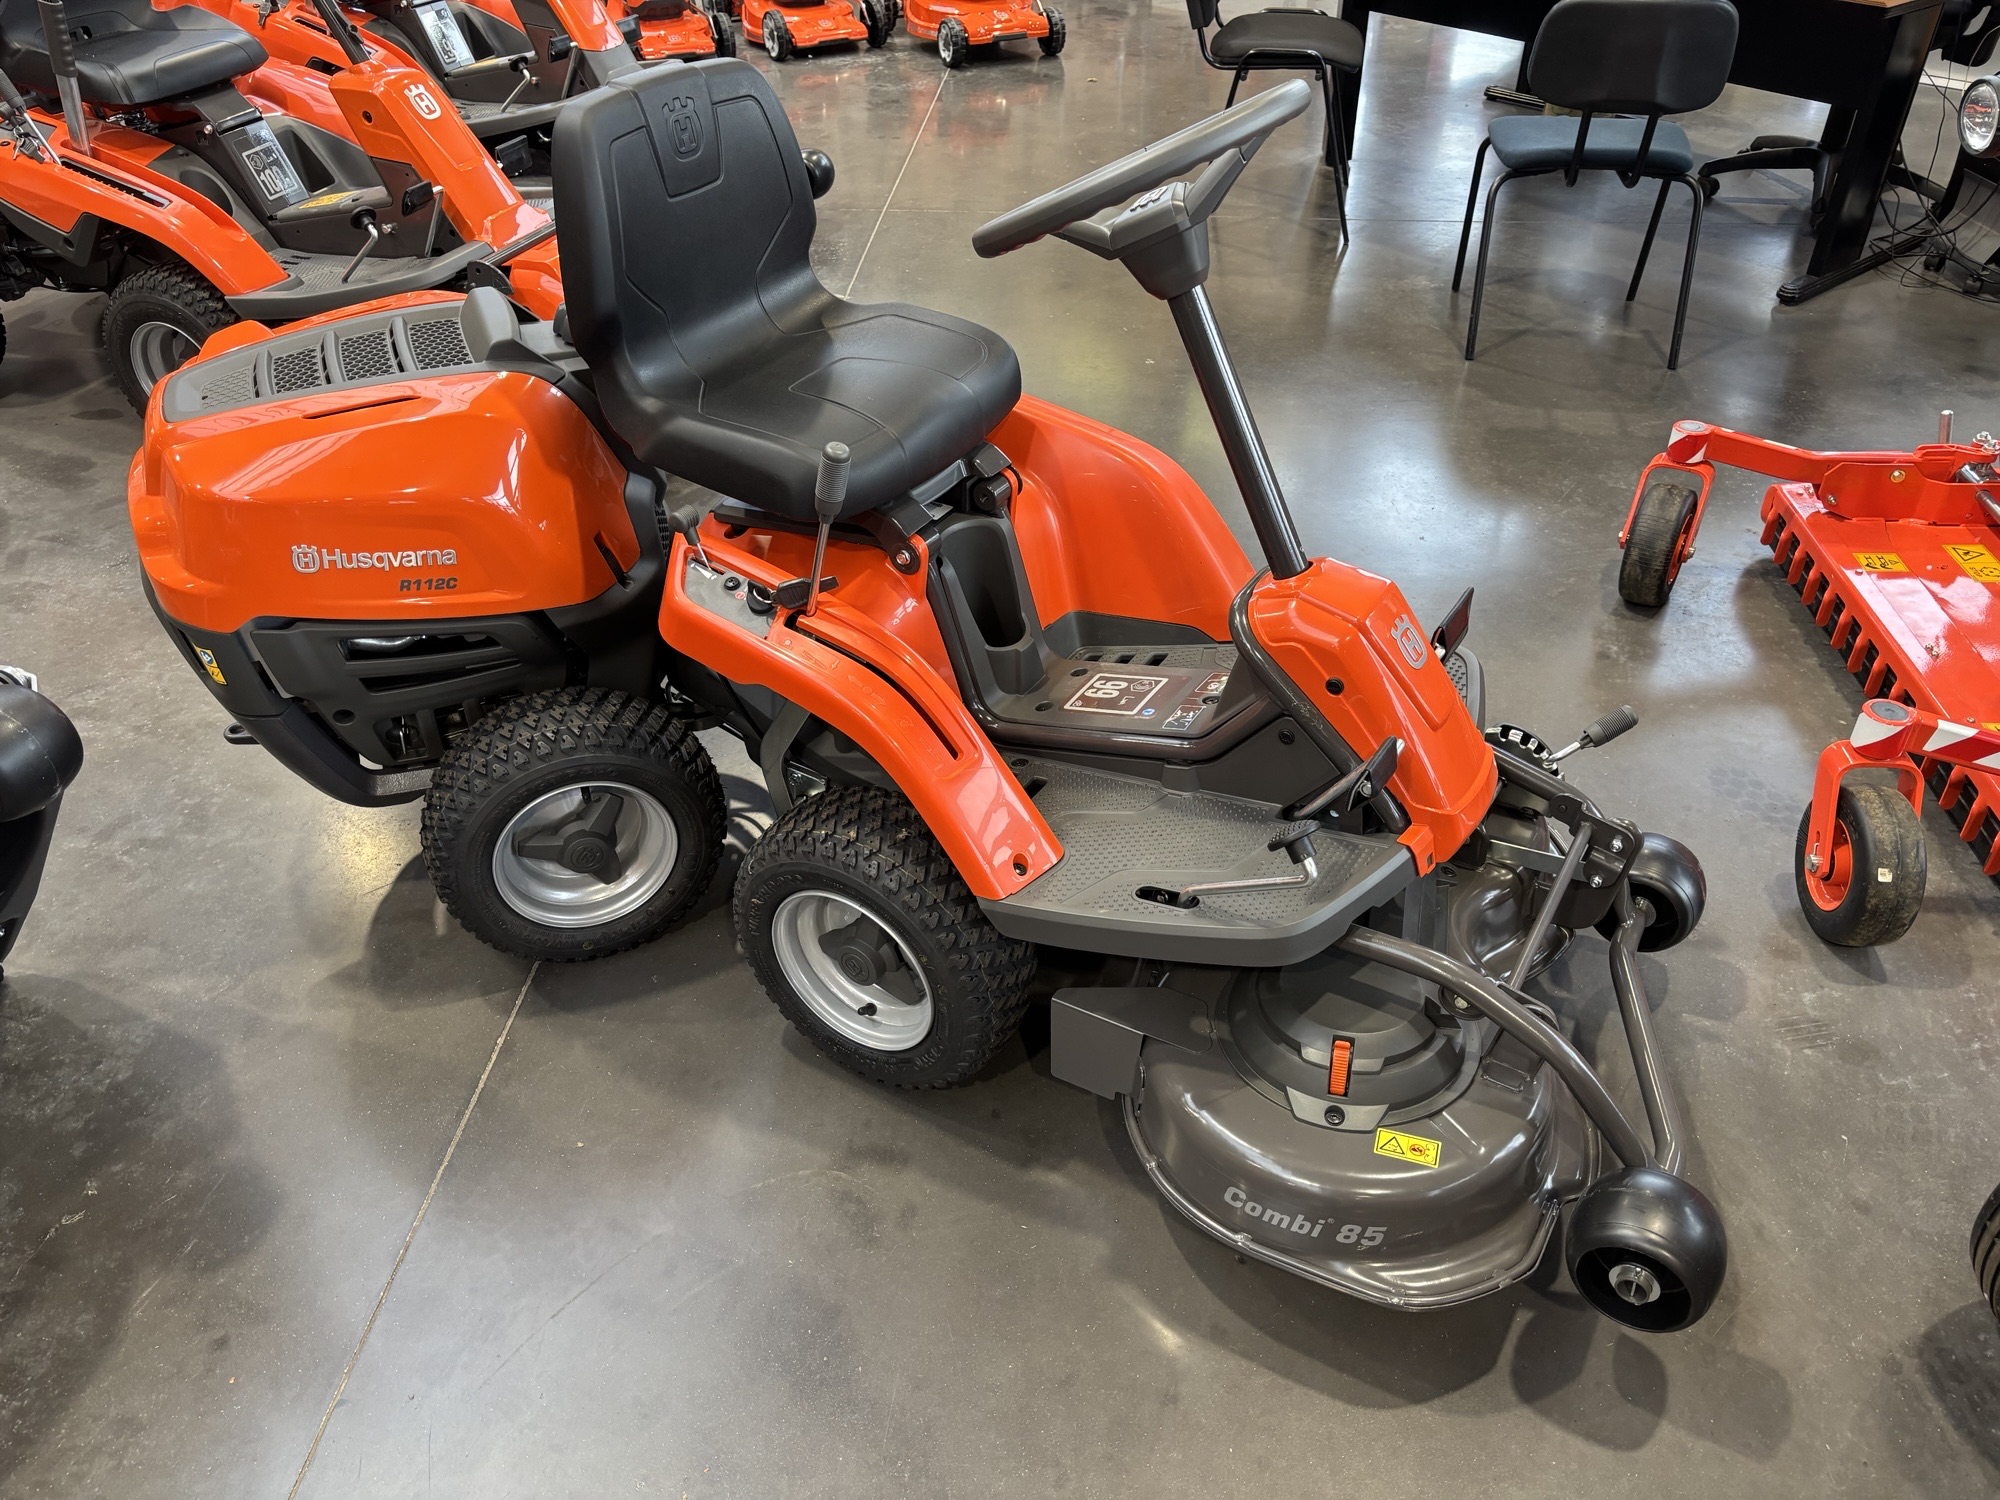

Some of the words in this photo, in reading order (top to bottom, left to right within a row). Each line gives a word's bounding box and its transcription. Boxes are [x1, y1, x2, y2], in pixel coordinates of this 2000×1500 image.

[321, 549, 458, 572] Husqvarna
[400, 577, 458, 592] R112C
[1335, 1224, 1388, 1246] 85
